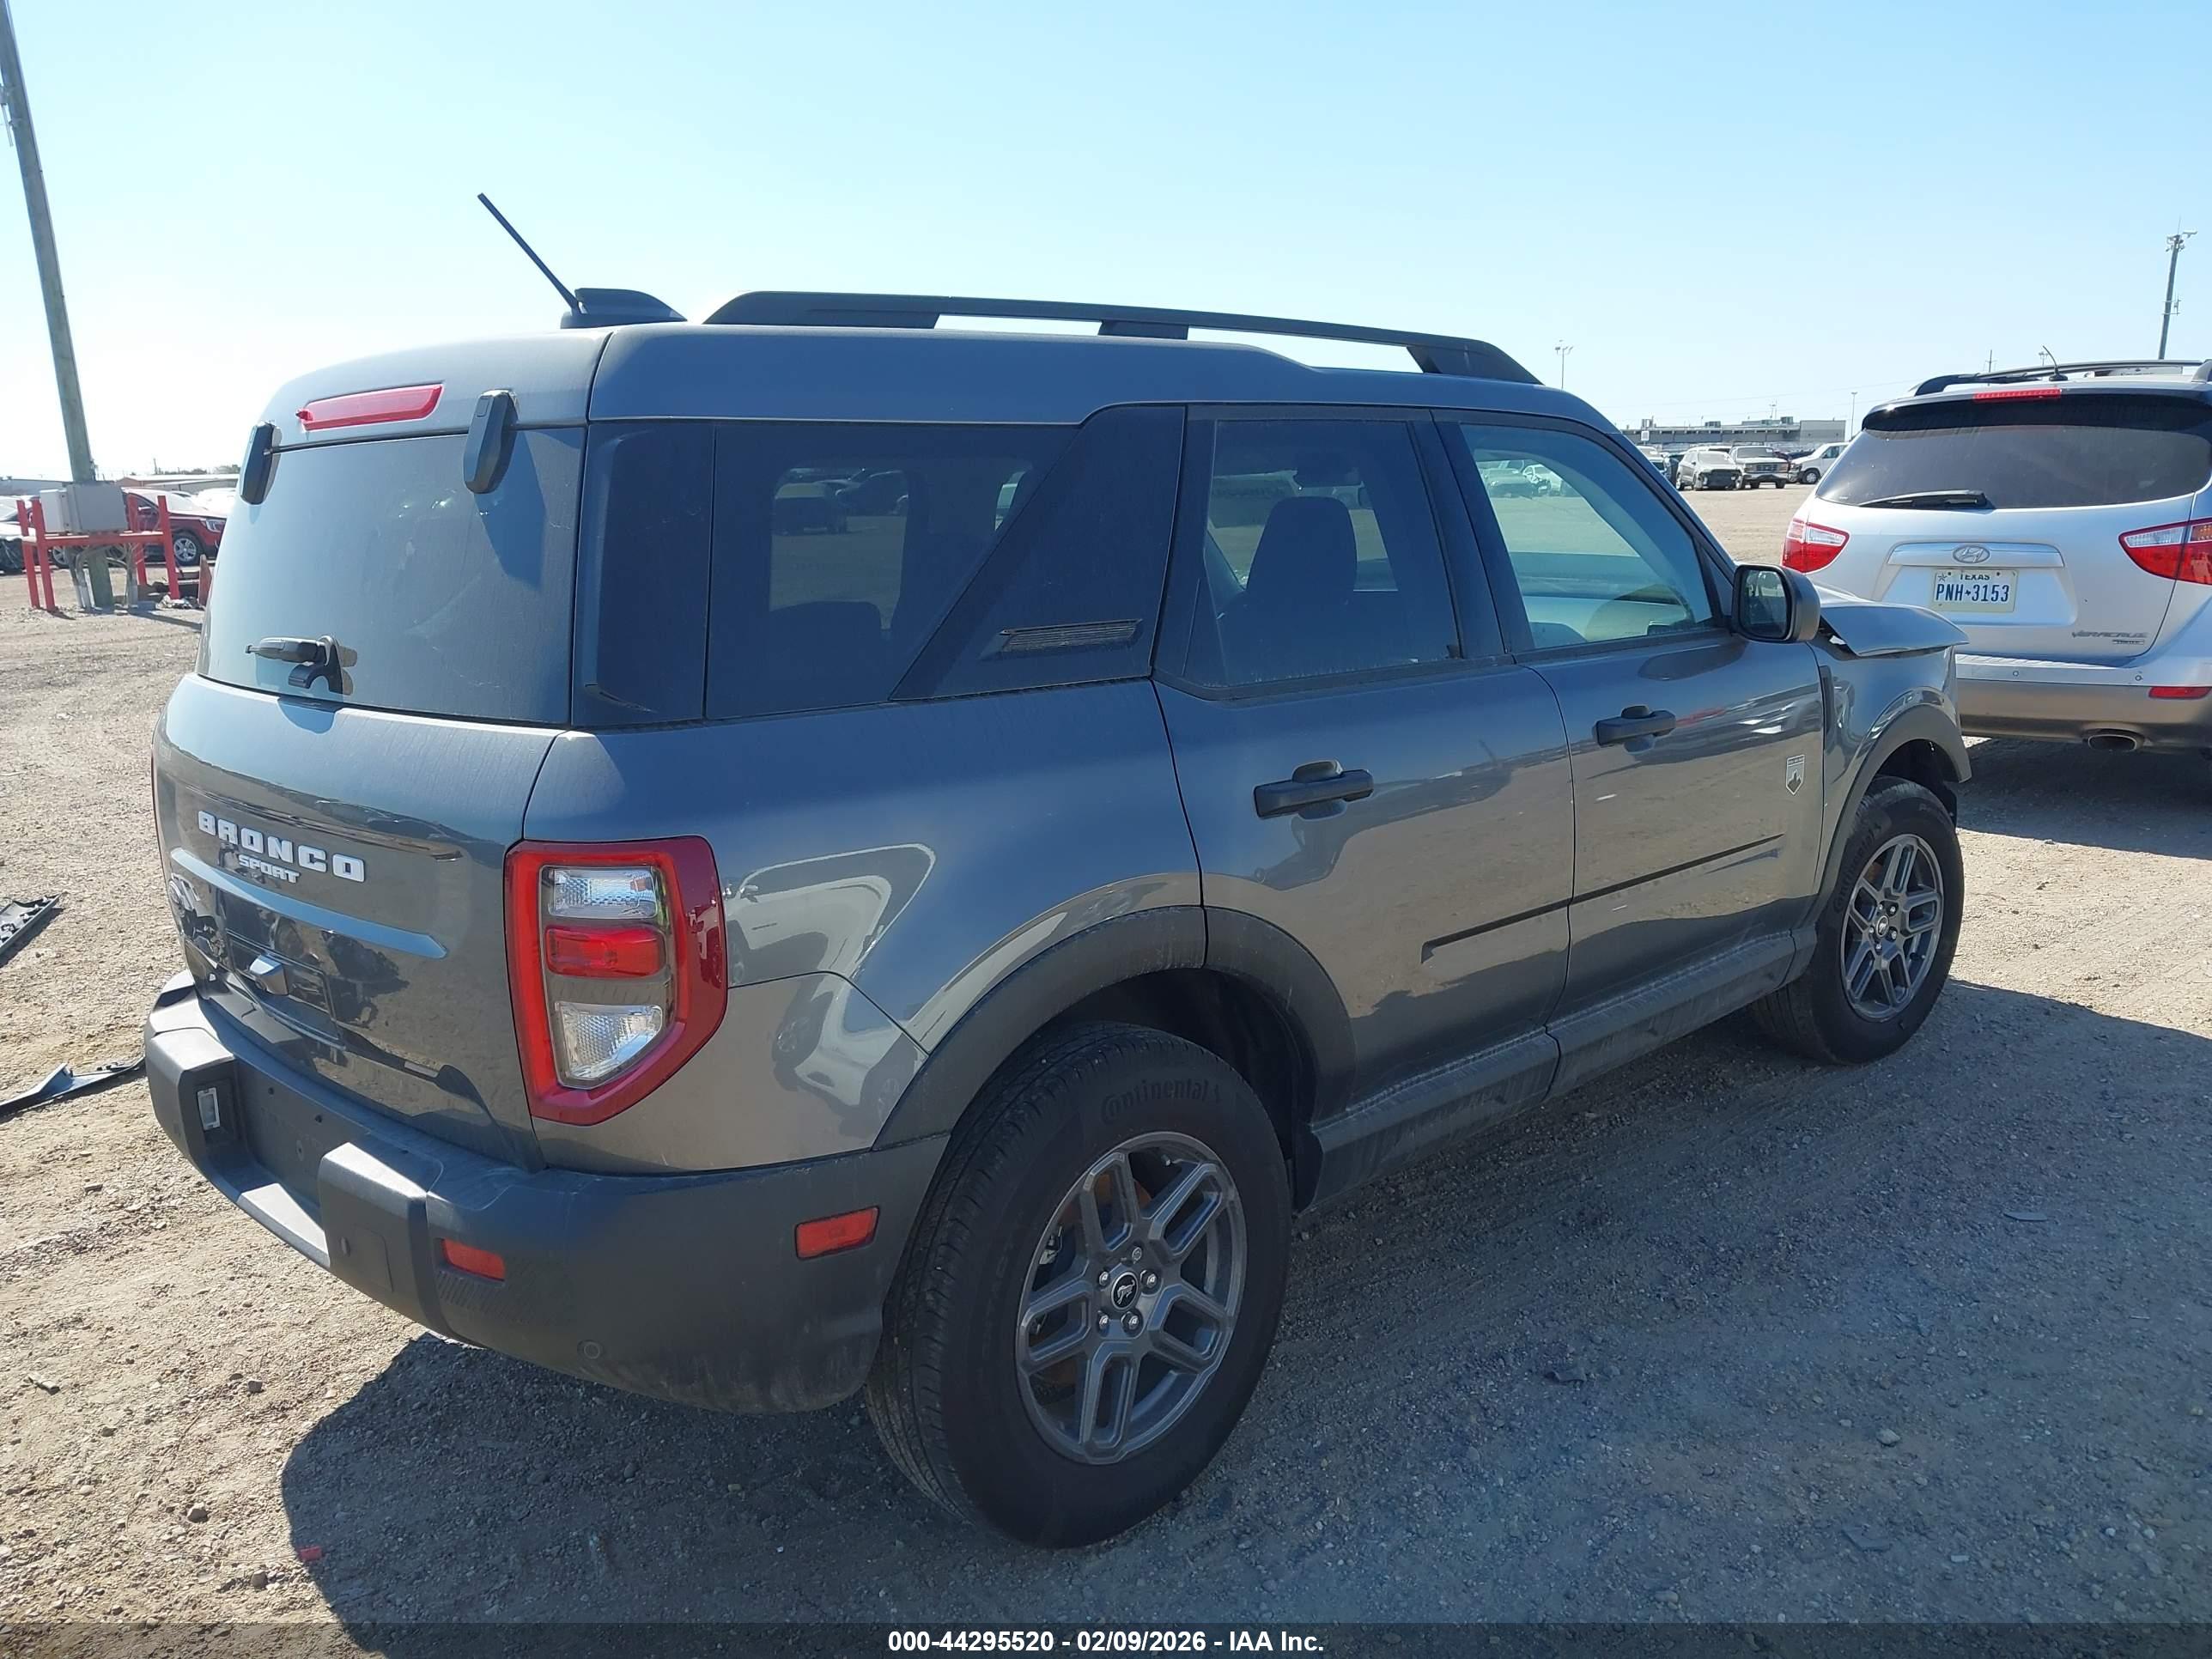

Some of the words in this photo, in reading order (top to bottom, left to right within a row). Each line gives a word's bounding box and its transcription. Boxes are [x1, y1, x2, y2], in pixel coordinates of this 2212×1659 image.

[1960, 573, 1990, 581] TEXAS
[198, 810, 365, 883] BRONCO
[238, 854, 301, 884] SPORT
[1102, 1078, 1209, 1126] Continental
